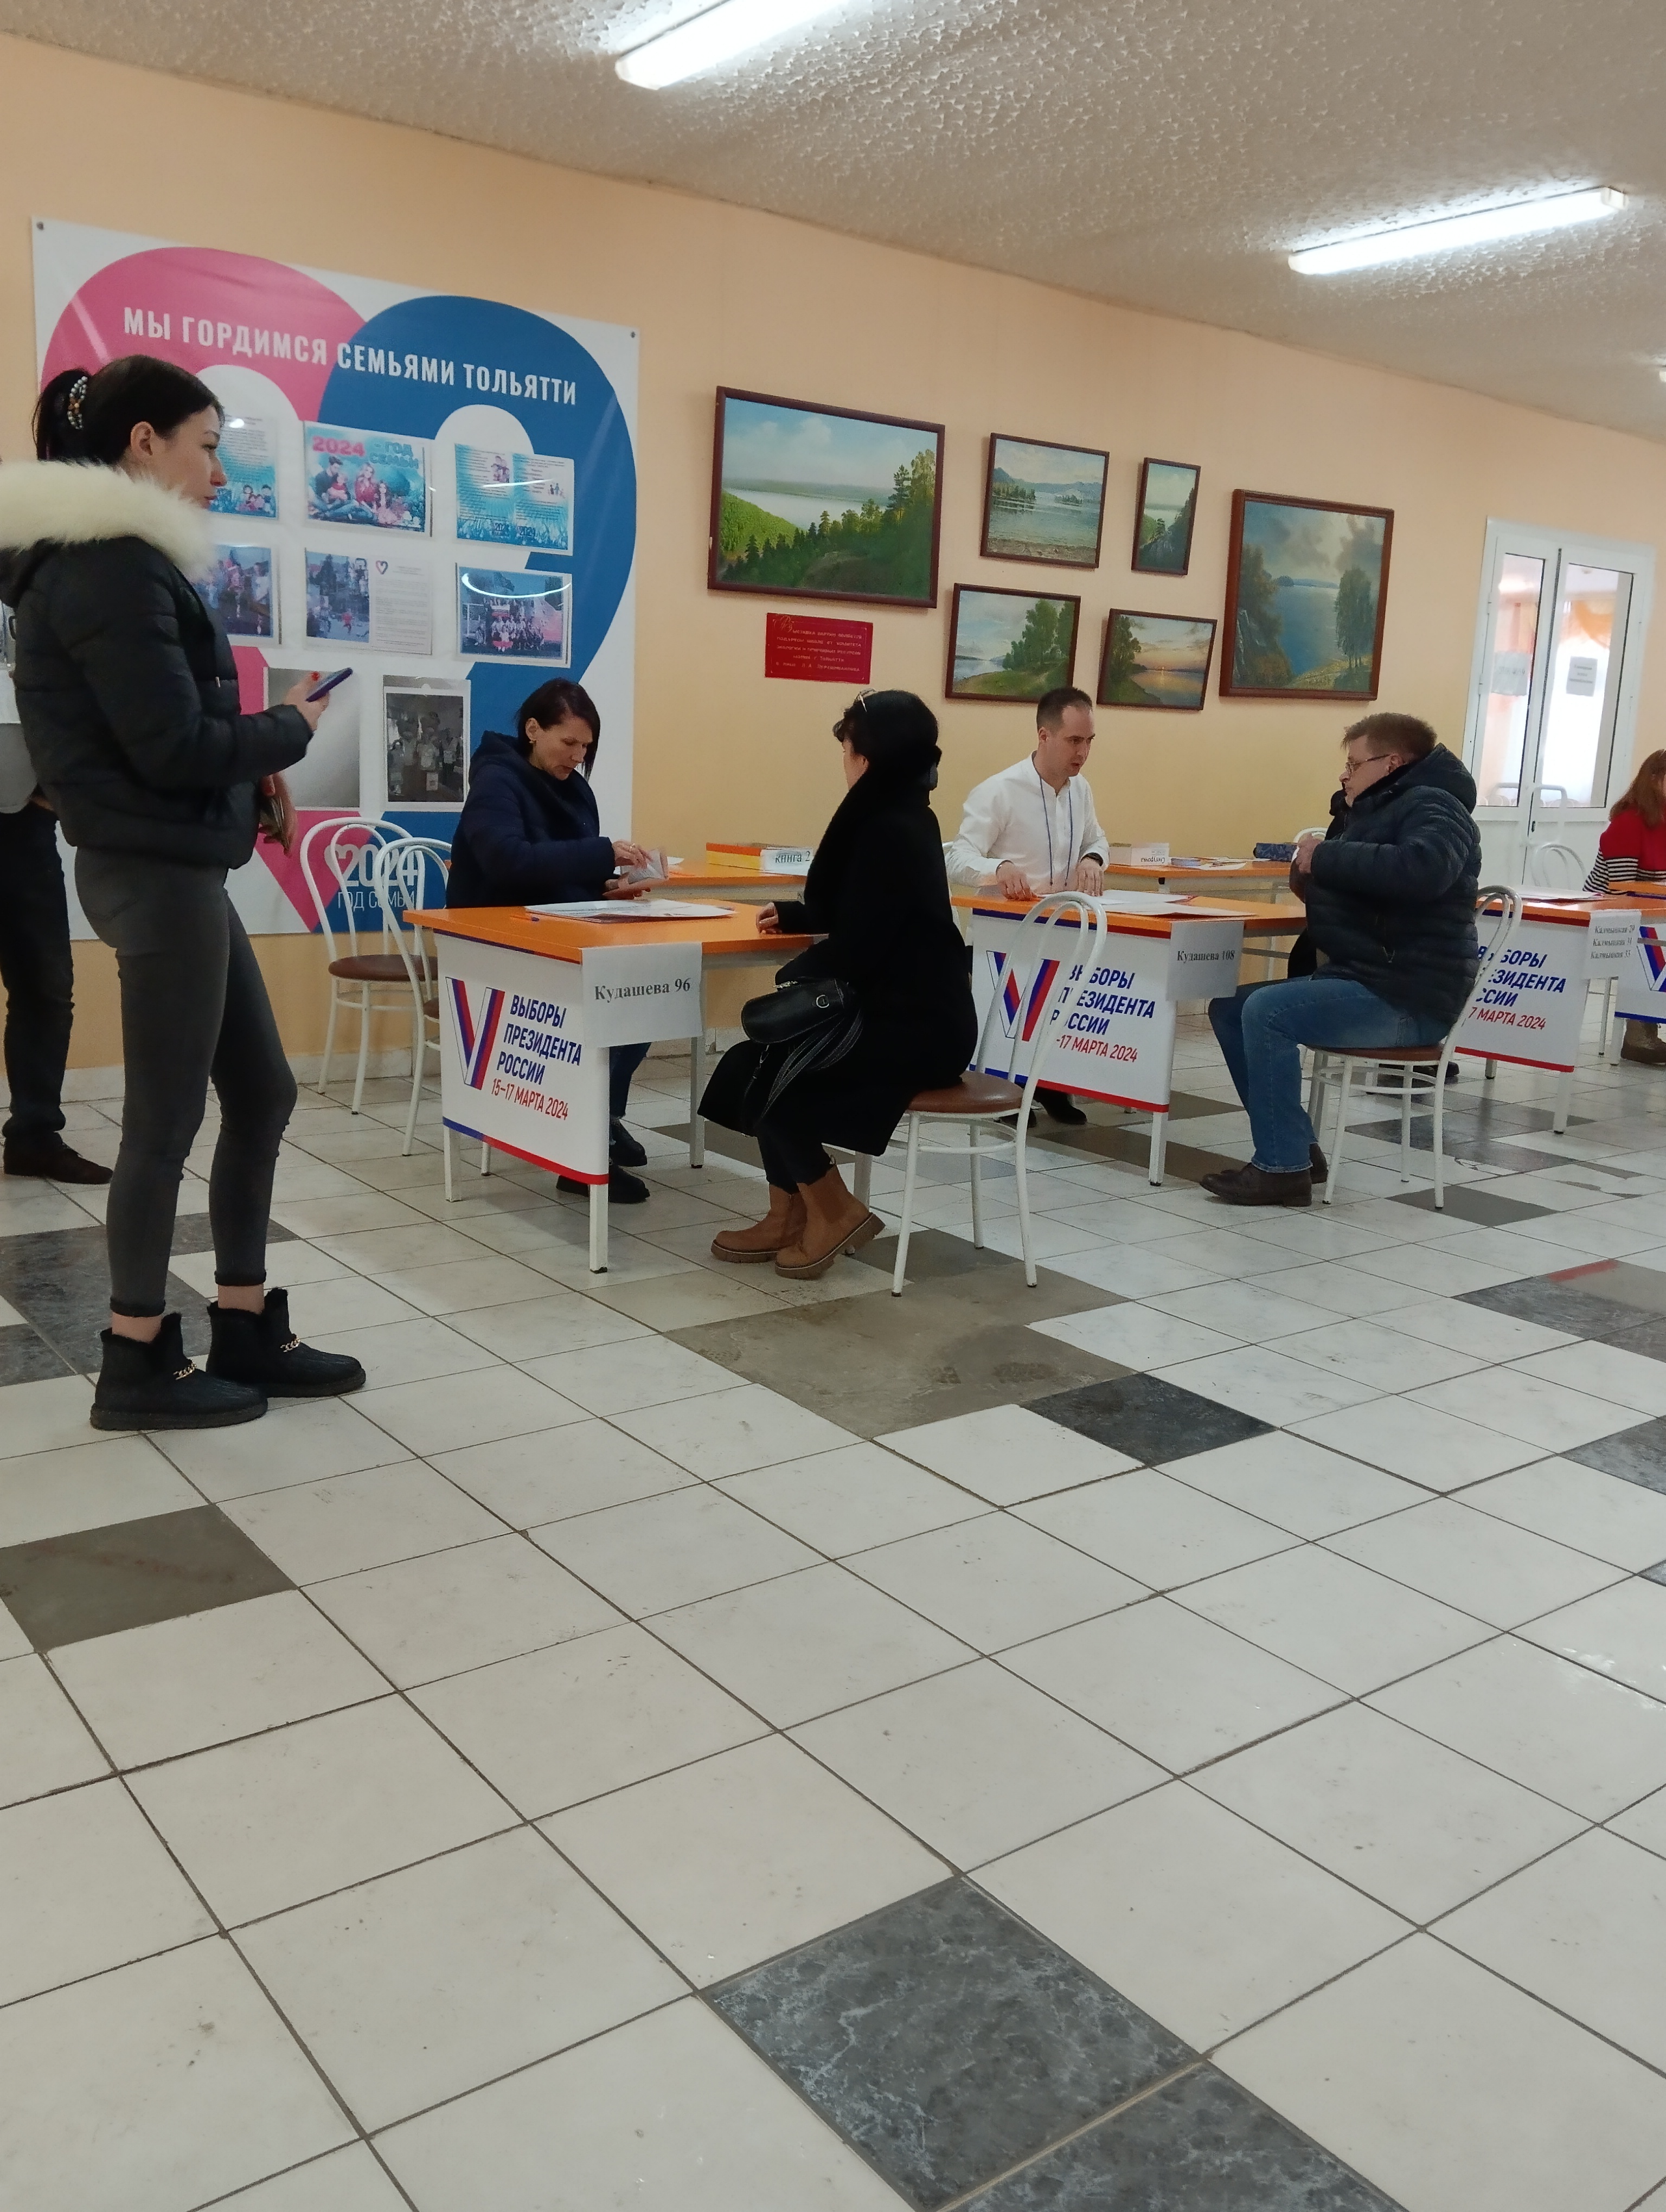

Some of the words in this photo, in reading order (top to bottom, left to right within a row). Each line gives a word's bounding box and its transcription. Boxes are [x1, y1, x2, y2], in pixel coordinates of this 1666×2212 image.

[124, 306, 171, 340] МЫ
[182, 316, 327, 365] ГОРДИМСЯ
[337, 343, 454, 386] СЕМЬЯМИ
[463, 363, 576, 406] ТОЛЬЯТТИ
[313, 436, 365, 457] 2024
[385, 441, 414, 457] ГОД
[774, 854, 802, 863] книга
[805, 850, 811, 861] 2
[369, 891, 414, 909] СМЬИ
[1176, 950, 1219, 964] Кудашева
[1222, 949, 1235, 960] 108
[1478, 946, 1548, 969] ВБОРЫ
[594, 983, 670, 1004] Кудашева
[674, 978, 691, 993] 96
[1487, 968, 1567, 993] ЗИДЕНТА
[1058, 987, 1156, 1019] ПЕЗИДЕНТА
[1475, 987, 1518, 1007] СИИ
[510, 994, 567, 1028] ВЫБОРЫ
[1049, 1009, 1111, 1036] РССИИ
[1476, 1008, 1516, 1026] МАРТА
[1516, 1014, 1546, 1030] 2024
[503, 1023, 582, 1066] ПРЕЗИДЕНТА
[1072, 1037, 1108, 1057] МАРТА
[1110, 1044, 1138, 1063] 2024
[496, 1051, 546, 1085] РОССИИ
[514, 1086, 544, 1113] МАРТА
[545, 1097, 568, 1121] 2024
